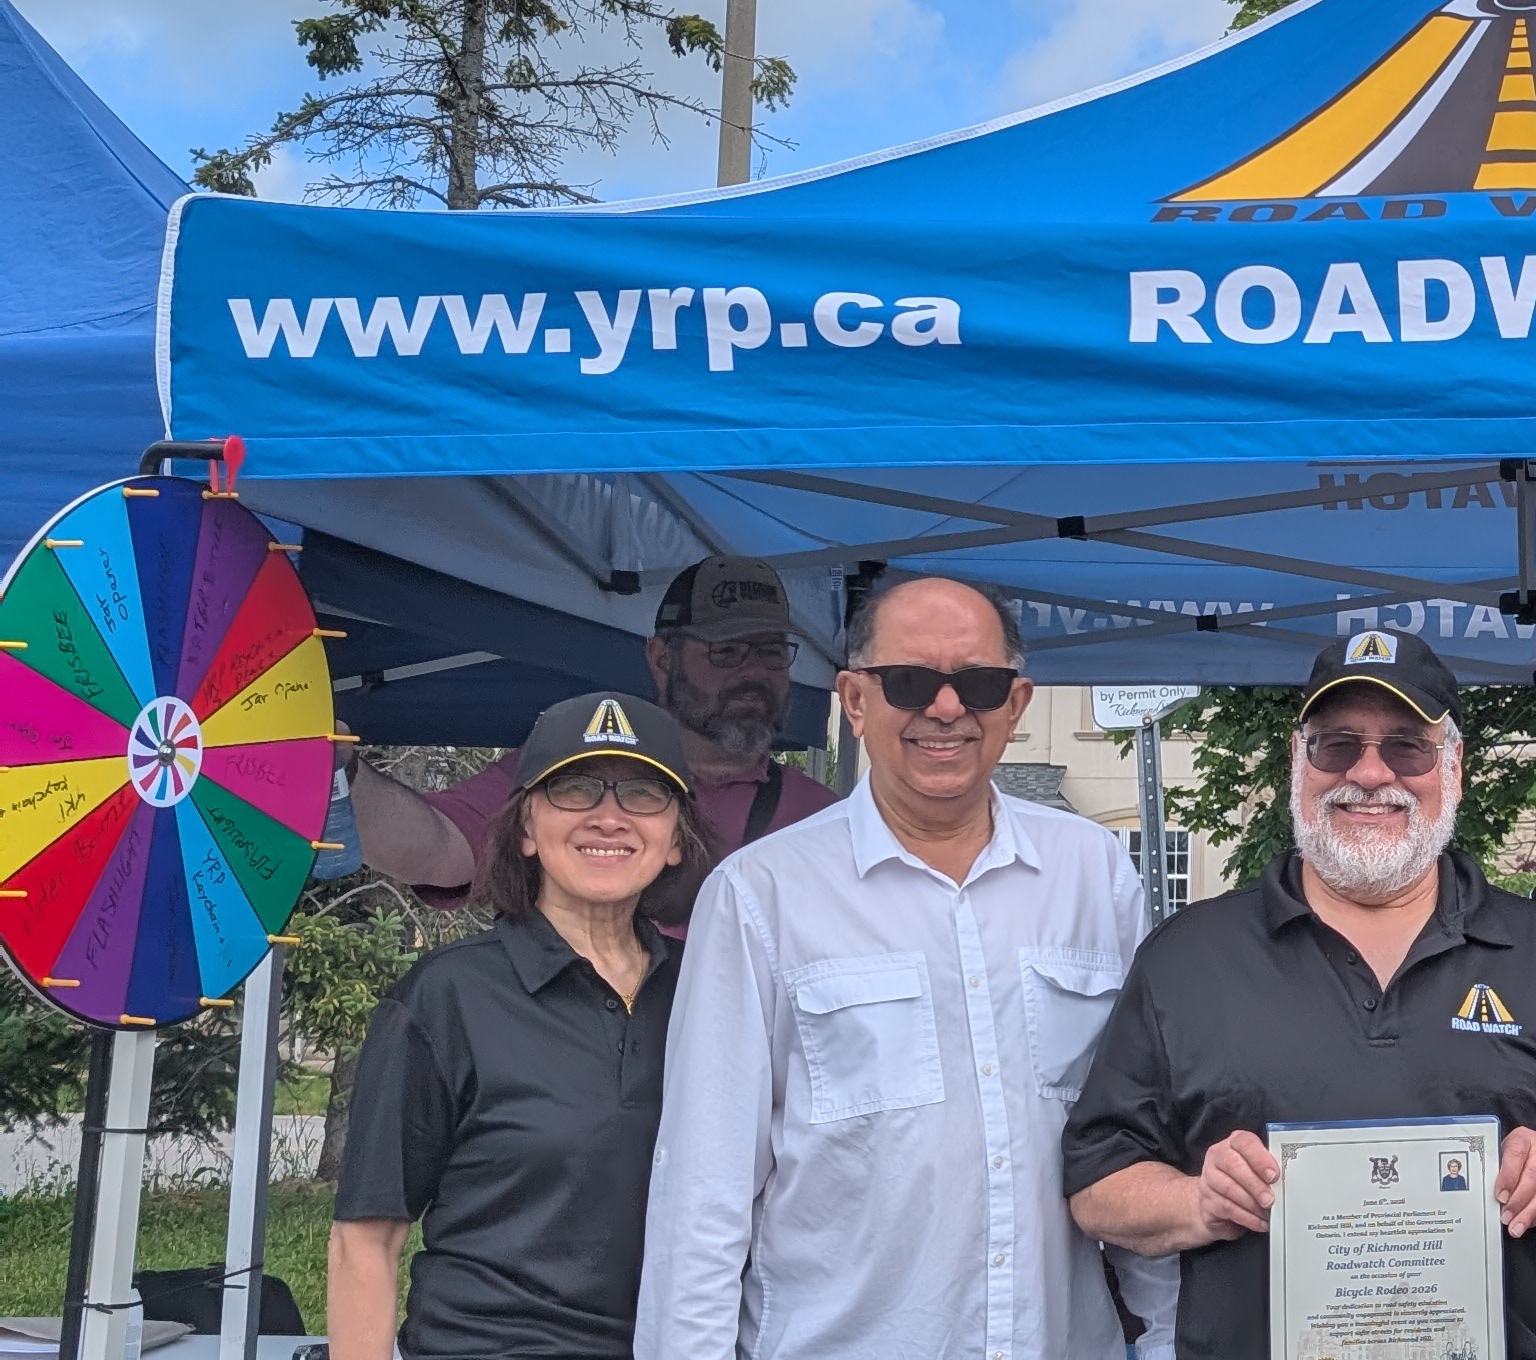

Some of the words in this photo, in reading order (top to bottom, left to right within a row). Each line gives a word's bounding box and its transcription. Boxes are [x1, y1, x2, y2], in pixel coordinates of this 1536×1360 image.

[1150, 197, 1449, 222] ROAD
[228, 286, 961, 375] www.yrp.ca
[1100, 691, 1114, 703] by
[1118, 689, 1156, 700] Permit
[1160, 686, 1190, 698] Only.
[202, 848, 226, 886] YRP
[1452, 1017, 1481, 1031] ROAD
[1482, 1021, 1519, 1036] WATCH
[1328, 1244, 1350, 1256] City
[1353, 1243, 1365, 1255] of
[1366, 1241, 1420, 1253] Richmond
[1423, 1240, 1443, 1250] Hill
[1326, 1257, 1385, 1270] Roadwatch
[1388, 1256, 1446, 1268] Committee
[1335, 1286, 1373, 1299] Bicycle
[1376, 1285, 1408, 1296] Rodeo
[1411, 1284, 1438, 1294] 2026
